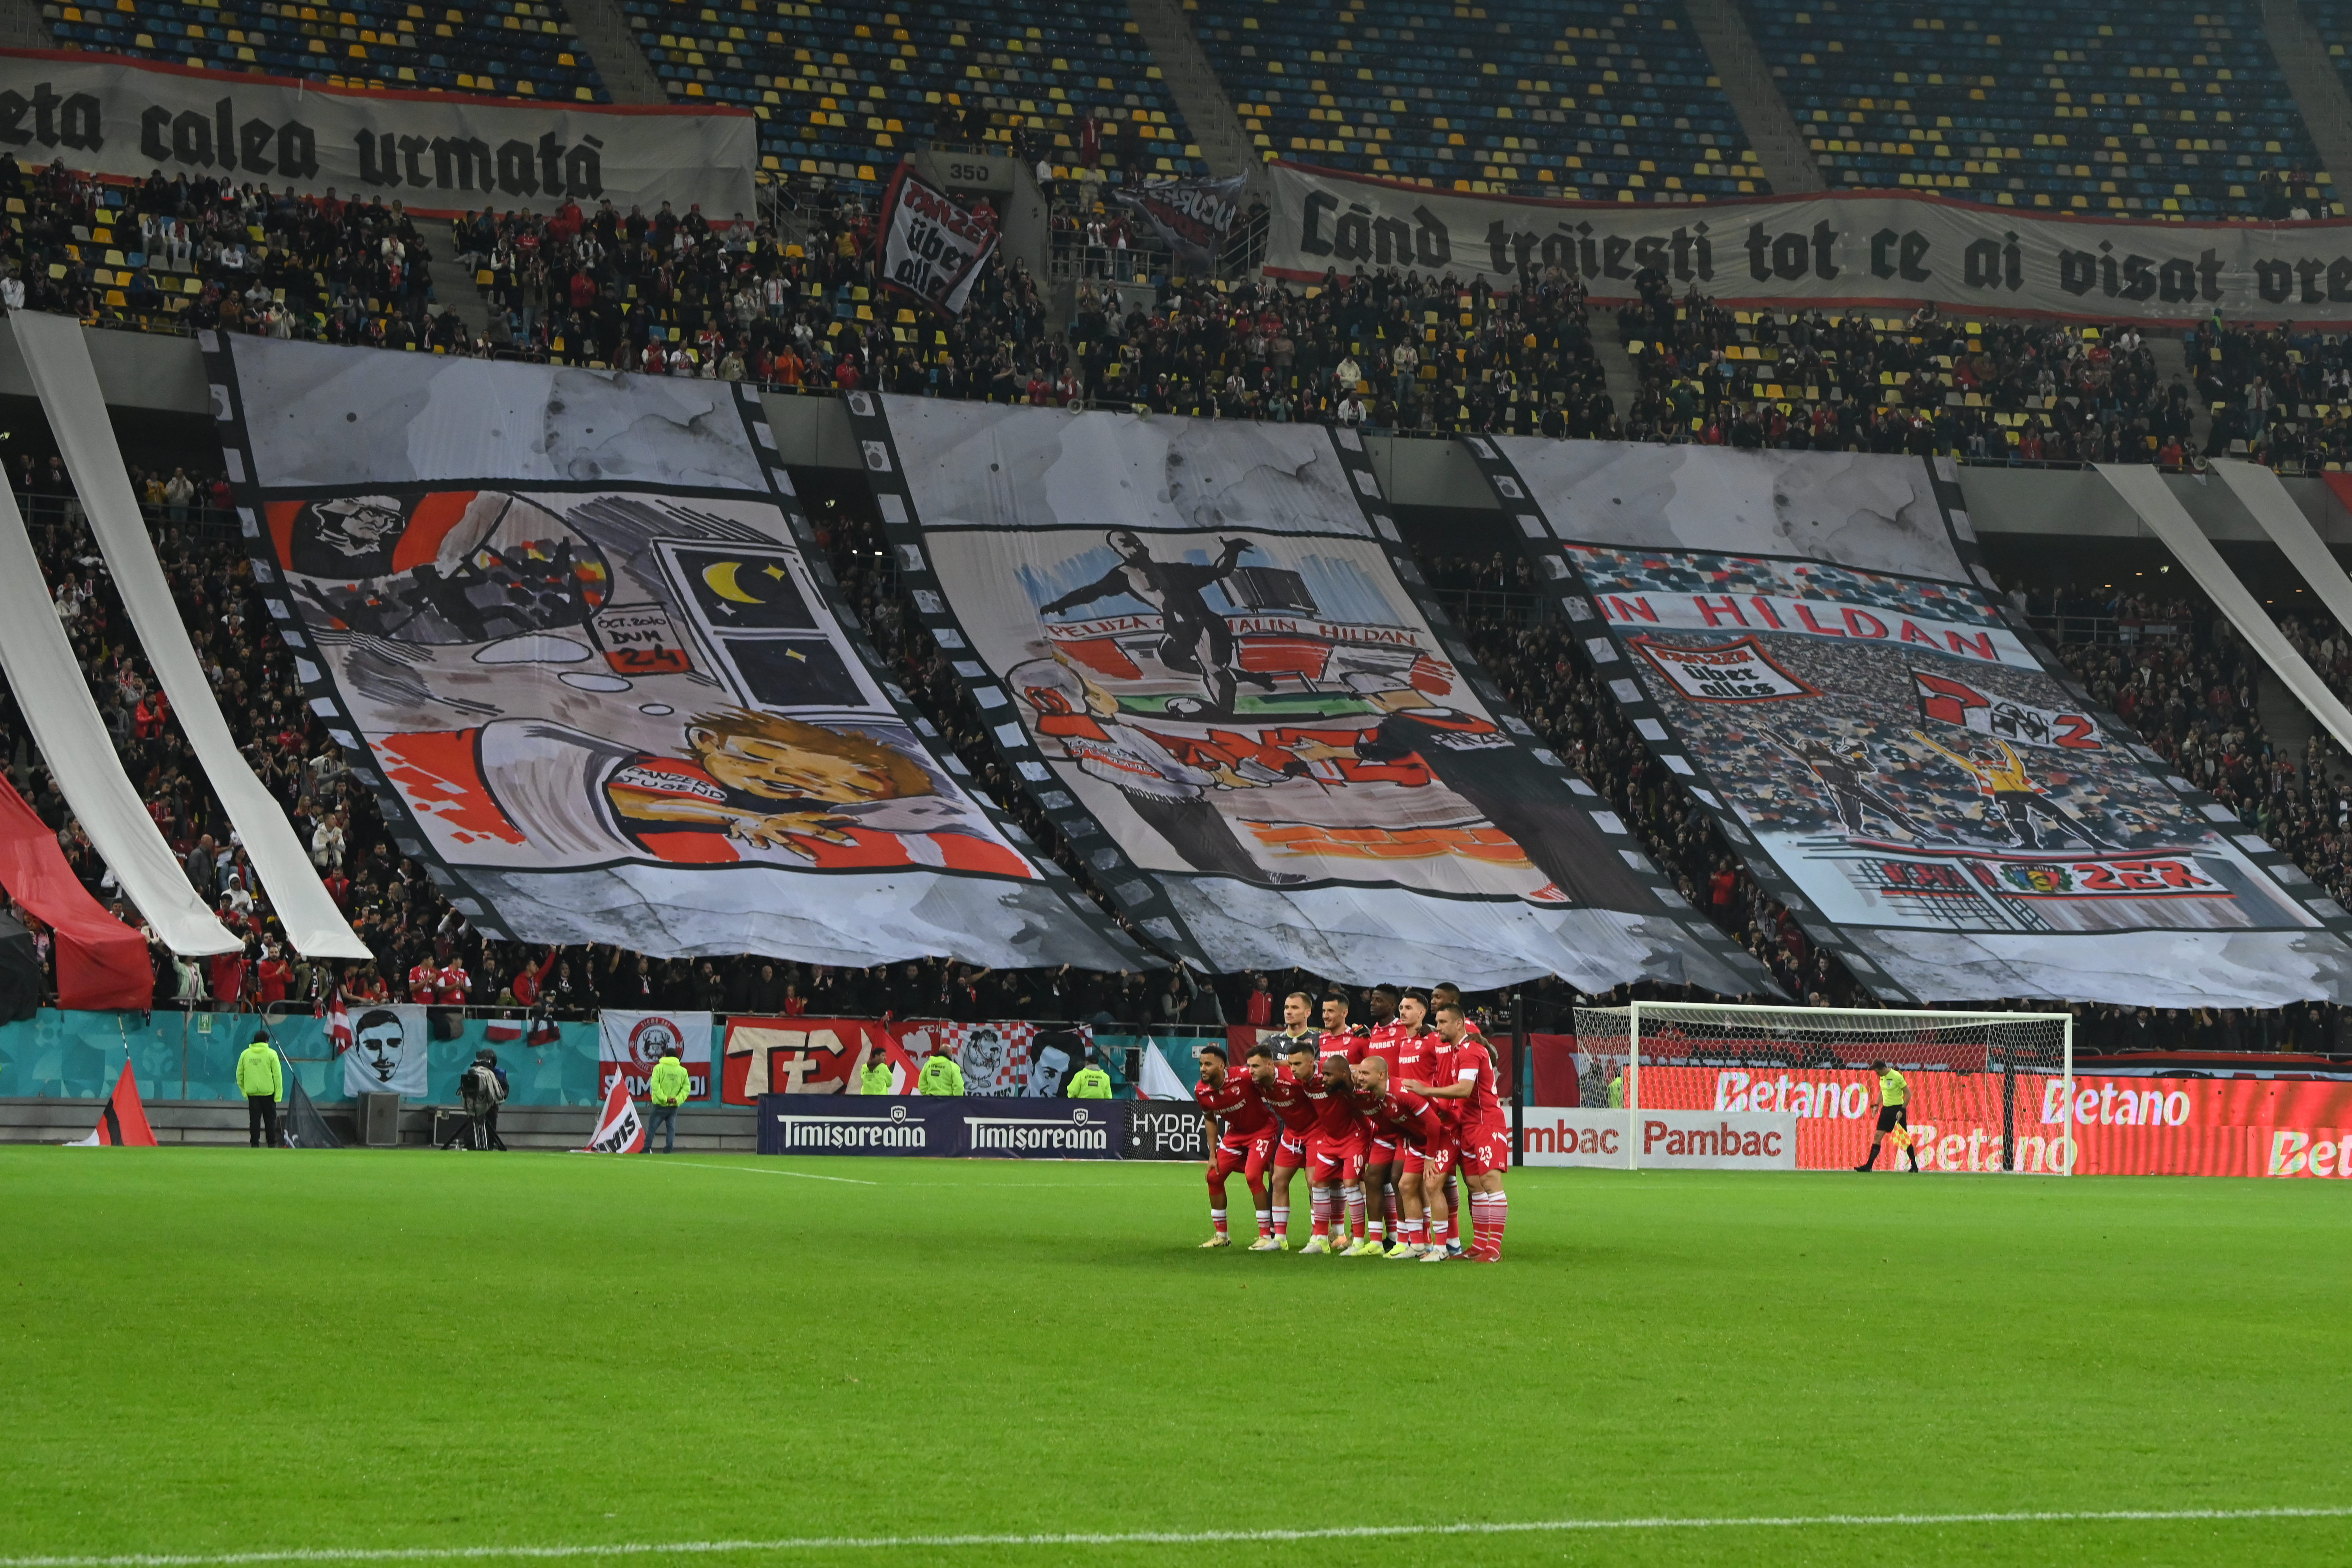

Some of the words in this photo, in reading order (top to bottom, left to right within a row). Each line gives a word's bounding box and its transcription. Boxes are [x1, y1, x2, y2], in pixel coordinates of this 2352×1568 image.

[0, 82, 104, 153] eta
[141, 96, 320, 180] calea
[950, 164, 988, 181] 350
[1744, 218, 1839, 283] tot
[1870, 227, 1932, 283] ce
[1964, 230, 2025, 292] ai
[2057, 239, 2226, 304] visat
[1319, 625, 1416, 647] HILDAN
[1693, 595, 2000, 662] HILDAN
[617, 644, 681, 666] 24
[1681, 664, 1759, 681] über
[1699, 681, 1777, 697] alles
[619, 775, 727, 799] JUGEND
[1714, 1072, 1869, 1119] Betano
[2041, 1079, 2190, 1126] Betano
[1155, 1133, 1200, 1153] FOR
[1256, 1138, 1269, 1153] 27
[1644, 1120, 1781, 1156] Pambac
[1353, 1154, 1364, 1168] 10
[1435, 1149, 1449, 1163] 33
[1478, 1145, 1493, 1161] 23
